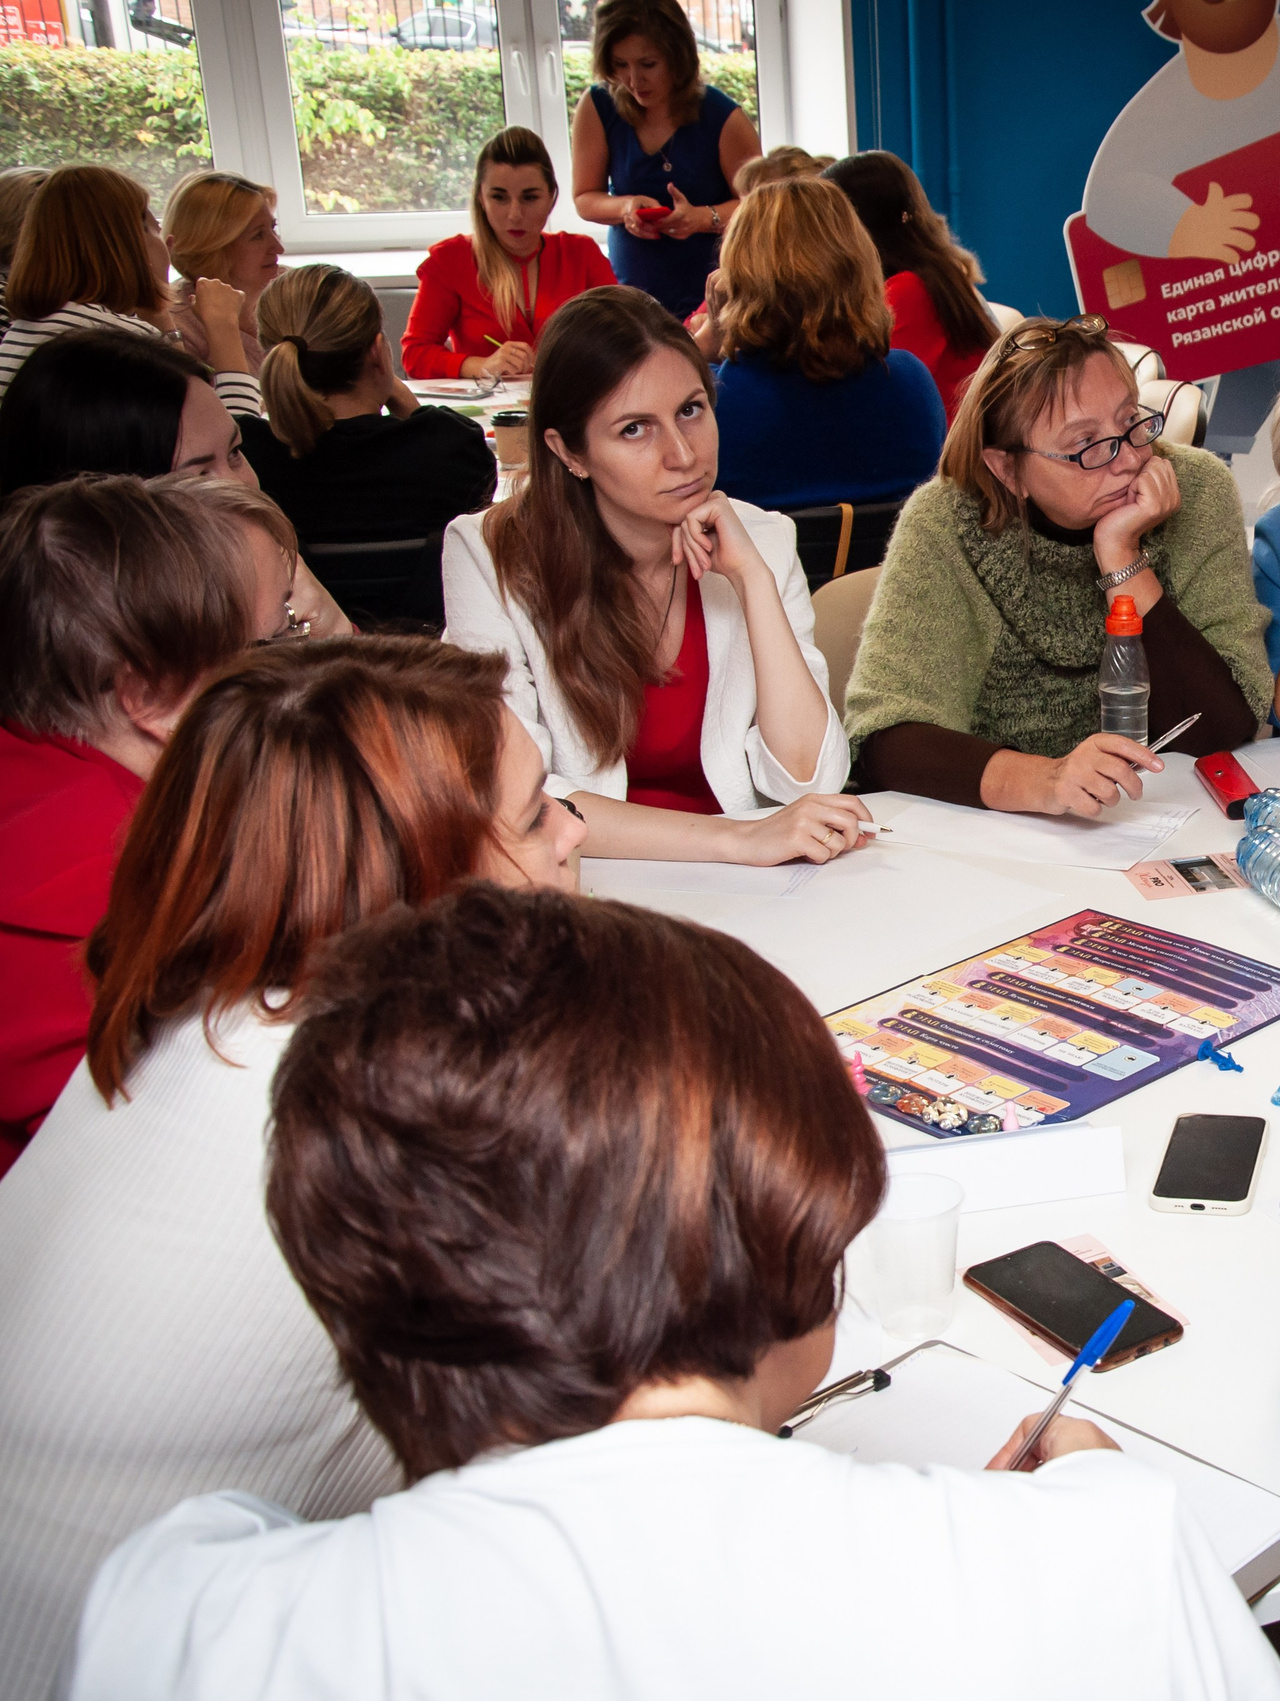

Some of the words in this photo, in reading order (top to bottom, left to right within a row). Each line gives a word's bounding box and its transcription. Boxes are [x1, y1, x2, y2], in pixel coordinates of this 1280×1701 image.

[1161, 268, 1225, 299] Единая
[1166, 298, 1216, 324] карта
[1171, 307, 1267, 348] Рязанской
[1122, 927, 1144, 936] ЭТАП
[1103, 935, 1127, 944] ЭТАП
[1088, 942, 1110, 951] ЭТАП
[1071, 950, 1092, 959] ЭТАП
[1006, 977, 1028, 987] ЭТАП
[987, 985, 1009, 996] ЭТАП
[916, 1015, 940, 1026] ЭТАП
[895, 1024, 920, 1036] ЭТАП
